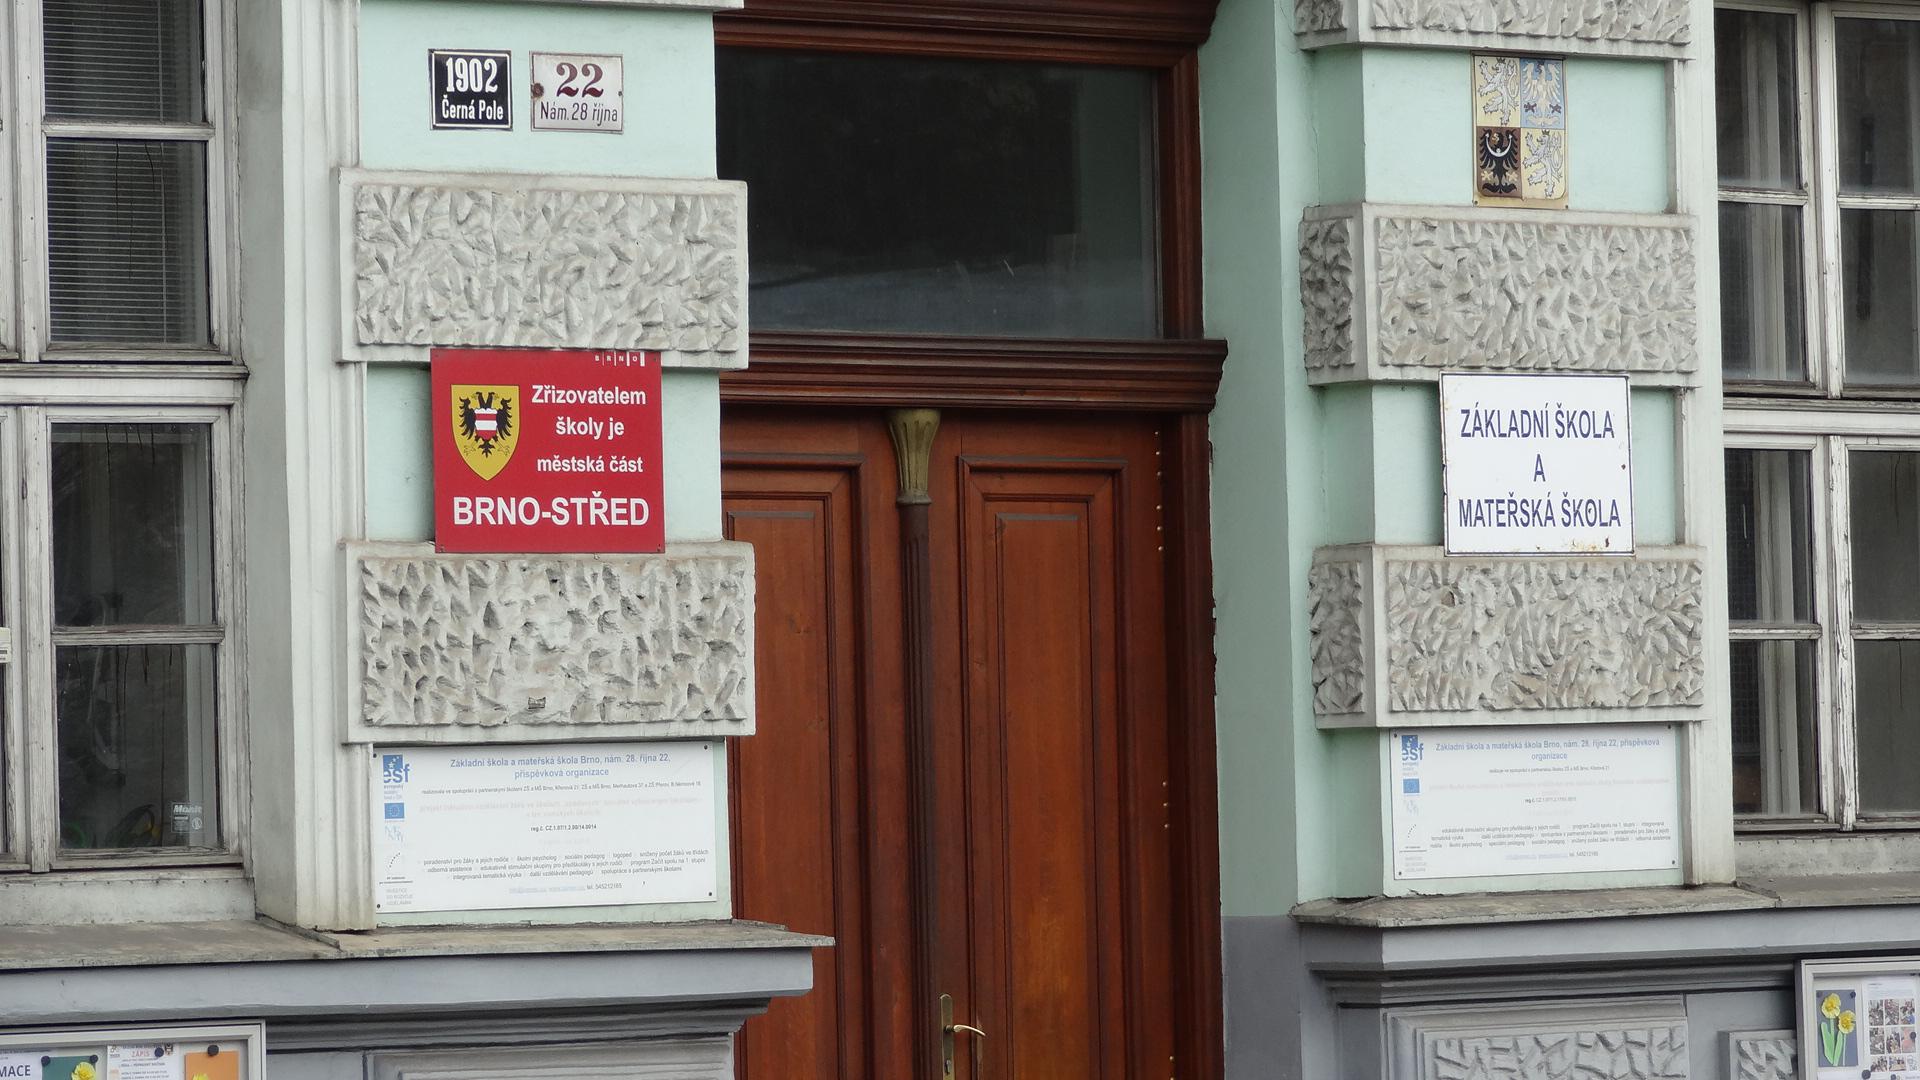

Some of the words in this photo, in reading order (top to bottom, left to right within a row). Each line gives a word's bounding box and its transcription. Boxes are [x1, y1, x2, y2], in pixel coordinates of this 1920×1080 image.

[446, 58, 498, 92] 1902
[557, 62, 603, 97] 22
[442, 94, 475, 120] Černá
[479, 100, 503, 120] Pole
[540, 101, 569, 121] Nám.
[572, 103, 588, 121] 28
[592, 102, 618, 126] října
[532, 384, 646, 405] Zřizovatelem
[556, 417, 603, 439] školy
[608, 417, 624, 440] je
[1460, 402, 1549, 437] ZÁKLADNÍ
[1555, 402, 1615, 438] ŠKOLA
[537, 456, 604, 472] městská
[609, 456, 643, 472] část
[1534, 454, 1546, 482] A
[453, 491, 649, 526] BRNO-STŘED
[1459, 492, 1556, 527] MATEŘSKÁ
[1562, 492, 1621, 527] ŠKOLA
[450, 758, 484, 767] Základní
[487, 758, 508, 766] škola
[518, 756, 554, 766] mateřská
[557, 756, 578, 764] škola
[581, 756, 602, 765] Brno,
[1532, 752, 1568, 761] organizace
[514, 769, 563, 780] příspěvková
[566, 768, 608, 778] organizace
